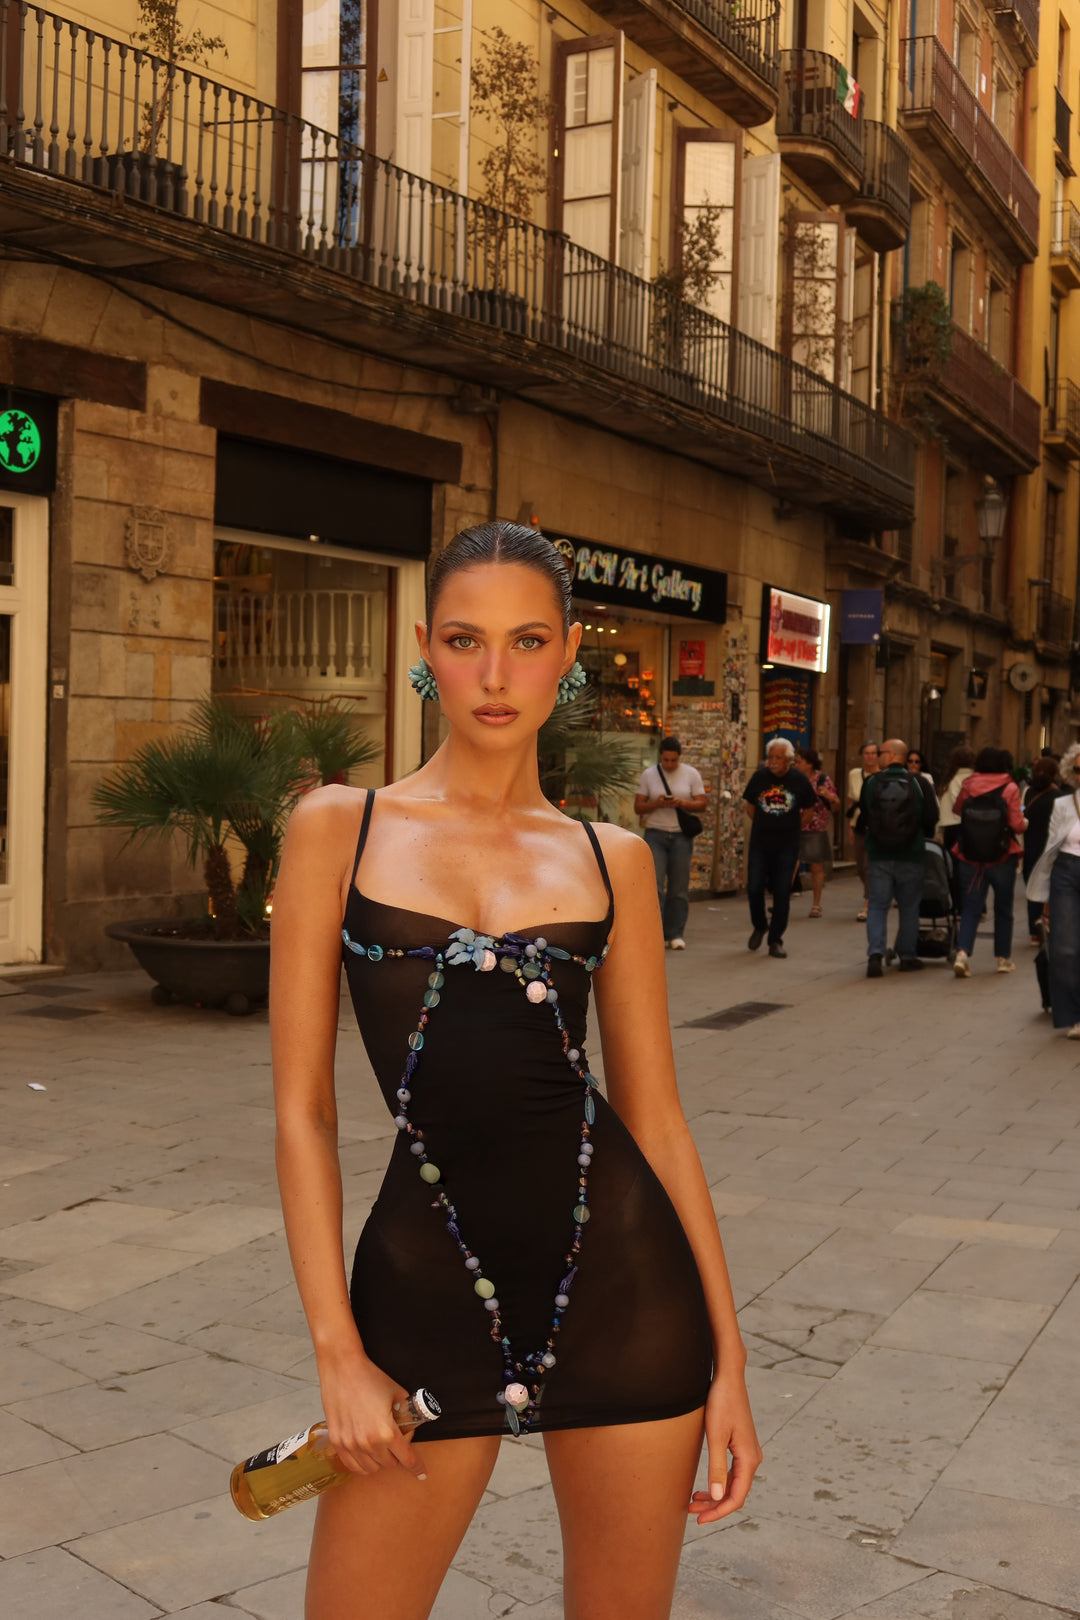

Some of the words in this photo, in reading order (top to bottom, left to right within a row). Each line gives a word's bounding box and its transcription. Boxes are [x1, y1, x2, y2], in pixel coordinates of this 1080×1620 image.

[577, 547, 618, 586] BCN
[618, 557, 648, 592] Art
[651, 564, 702, 612] Gallery
